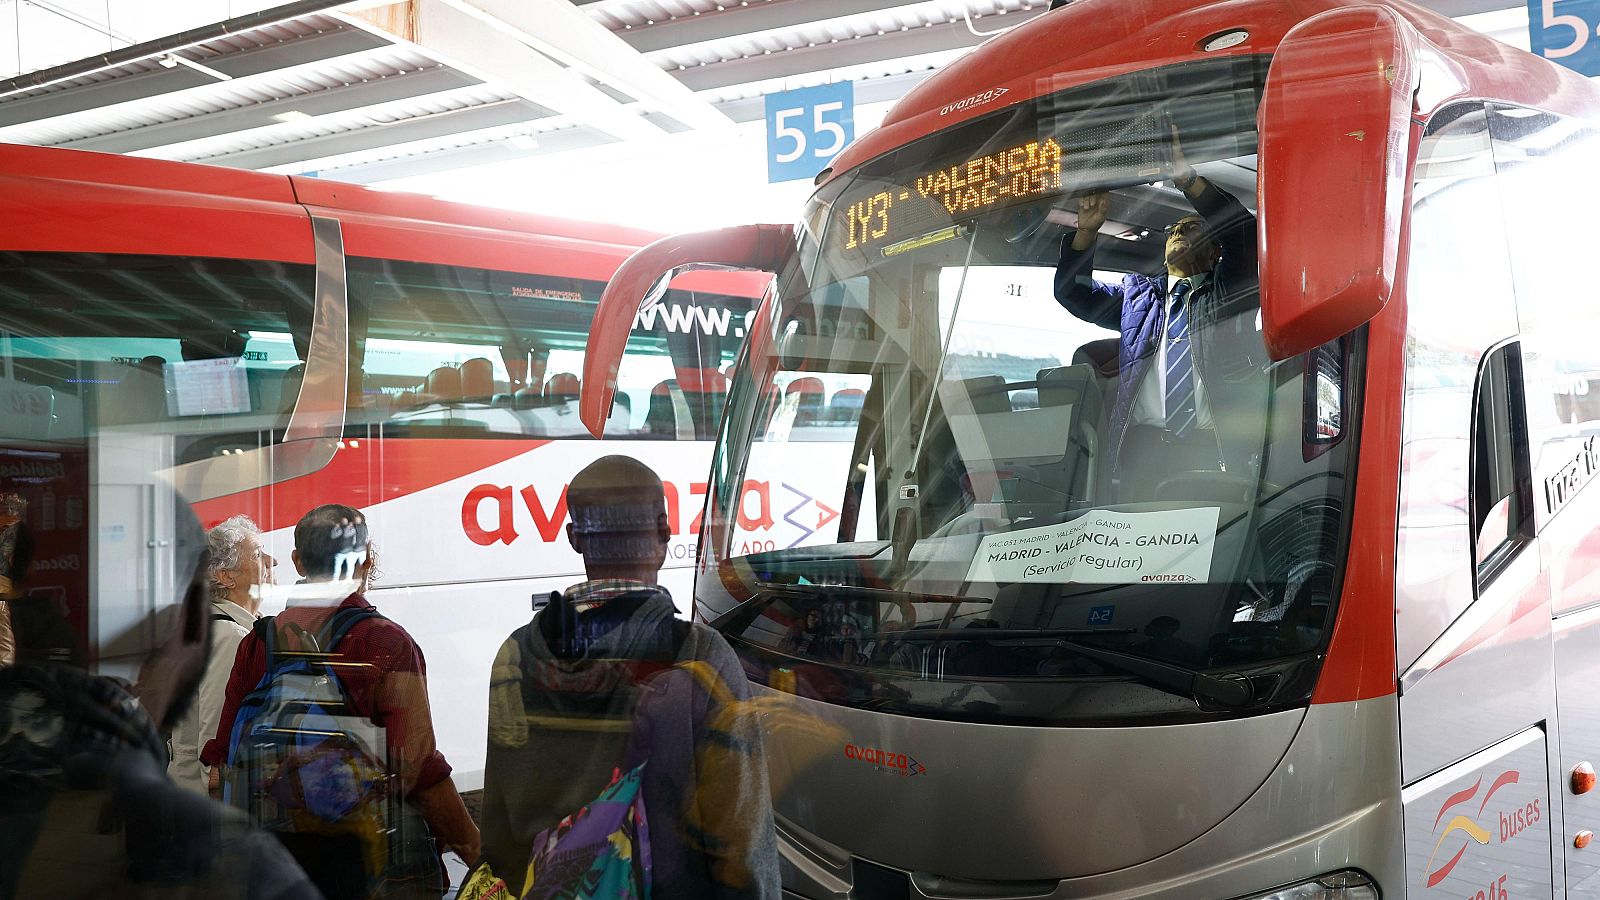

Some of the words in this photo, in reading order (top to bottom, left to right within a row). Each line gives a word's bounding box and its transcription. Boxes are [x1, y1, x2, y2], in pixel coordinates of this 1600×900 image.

[1542, 0, 1600, 58] 5
[940, 90, 993, 116] avanza
[776, 101, 845, 163] 55
[917, 138, 1062, 198] VALENCIA
[944, 163, 1063, 214] VAC-051
[988, 548, 1042, 563] MADRID
[1055, 532, 1119, 554] VALENCIA
[1135, 533, 1200, 546] GANDIA
[989, 540, 1018, 548] VAC.051
[1019, 534, 1050, 544] MADRID
[1056, 521, 1088, 538] VALENCIA
[1095, 519, 1132, 530] GANDIA
[1023, 556, 1076, 578] (Servicio
[1079, 554, 1143, 571] regular)
[1141, 574, 1185, 582] avanza
[844, 743, 908, 769] avanza
[1500, 798, 1540, 843] bus.es
